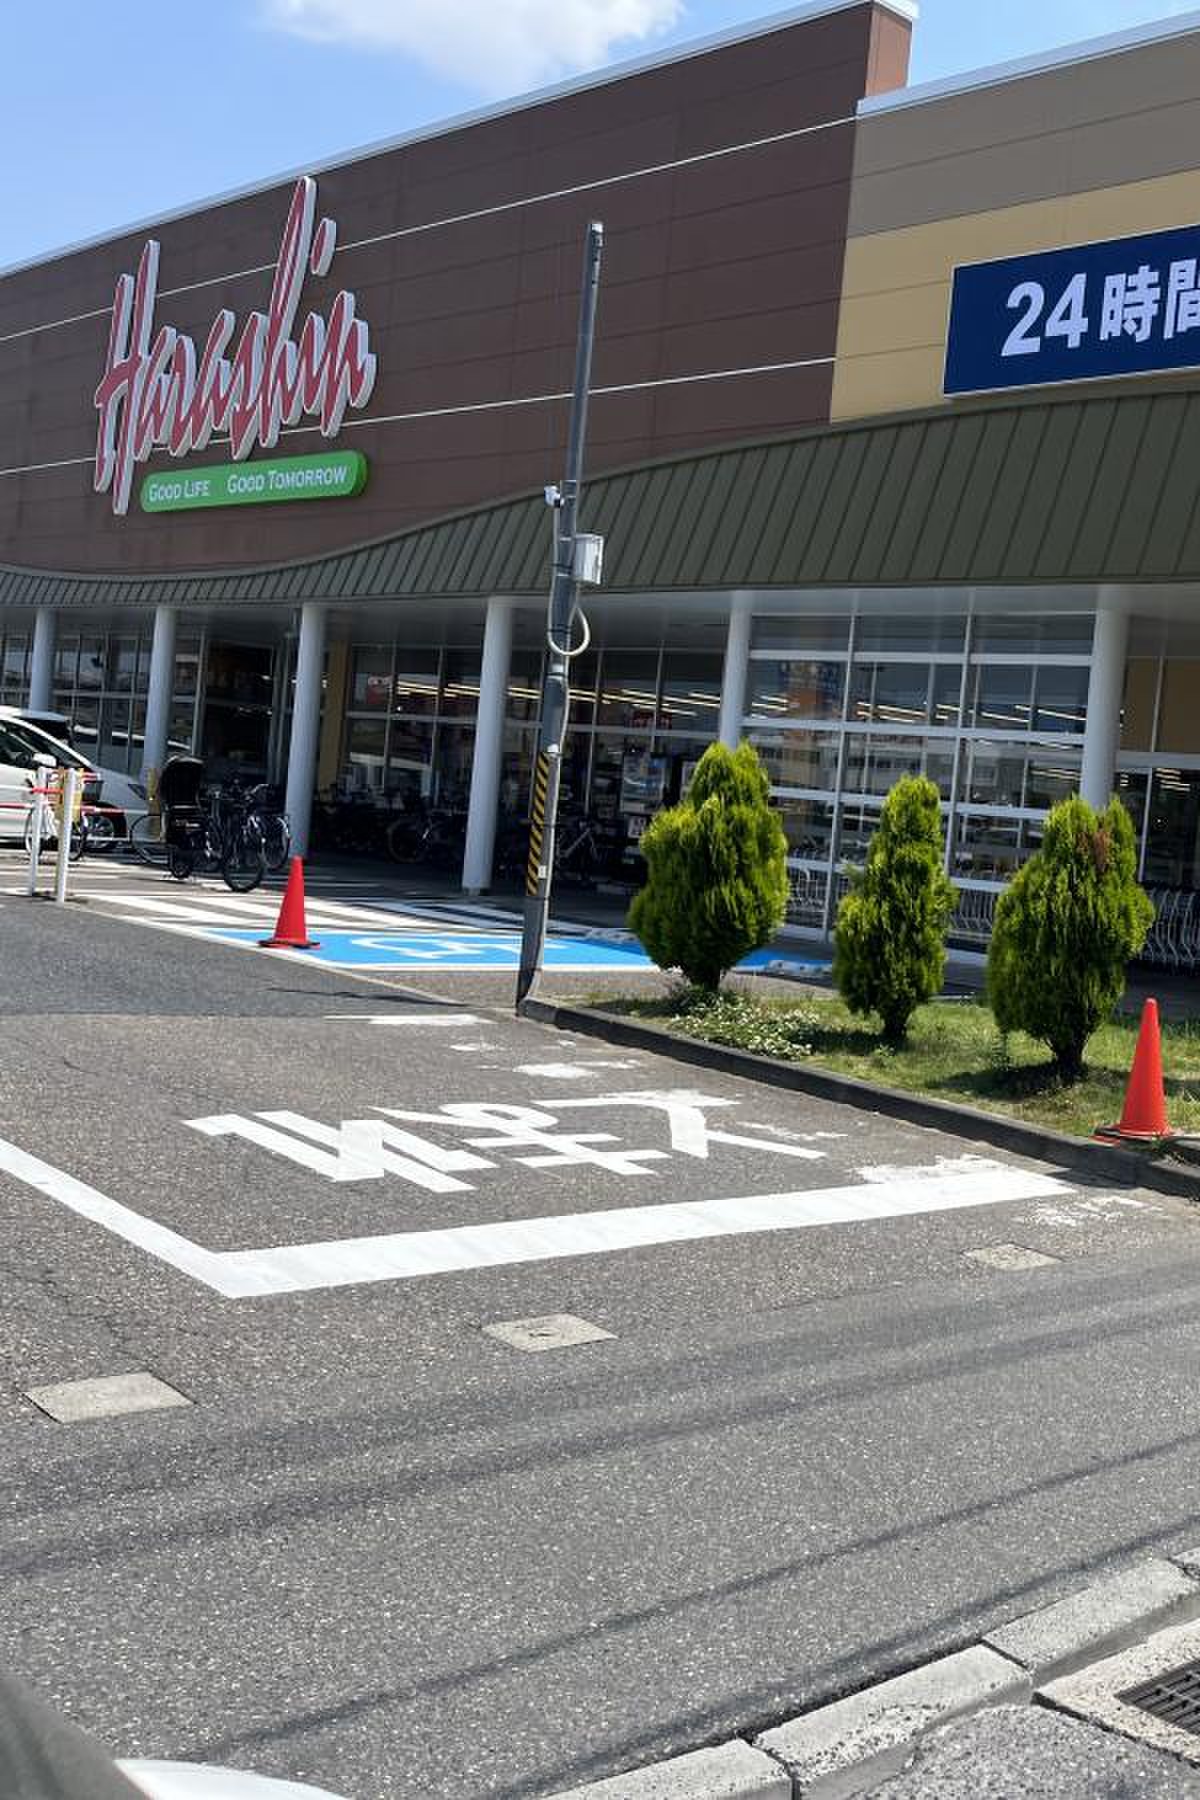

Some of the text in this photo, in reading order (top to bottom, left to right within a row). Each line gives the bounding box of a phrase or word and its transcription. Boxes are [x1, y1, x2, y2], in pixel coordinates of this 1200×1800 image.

[149, 466, 348, 502] GOOD LIFE GOOD TOMORROW
